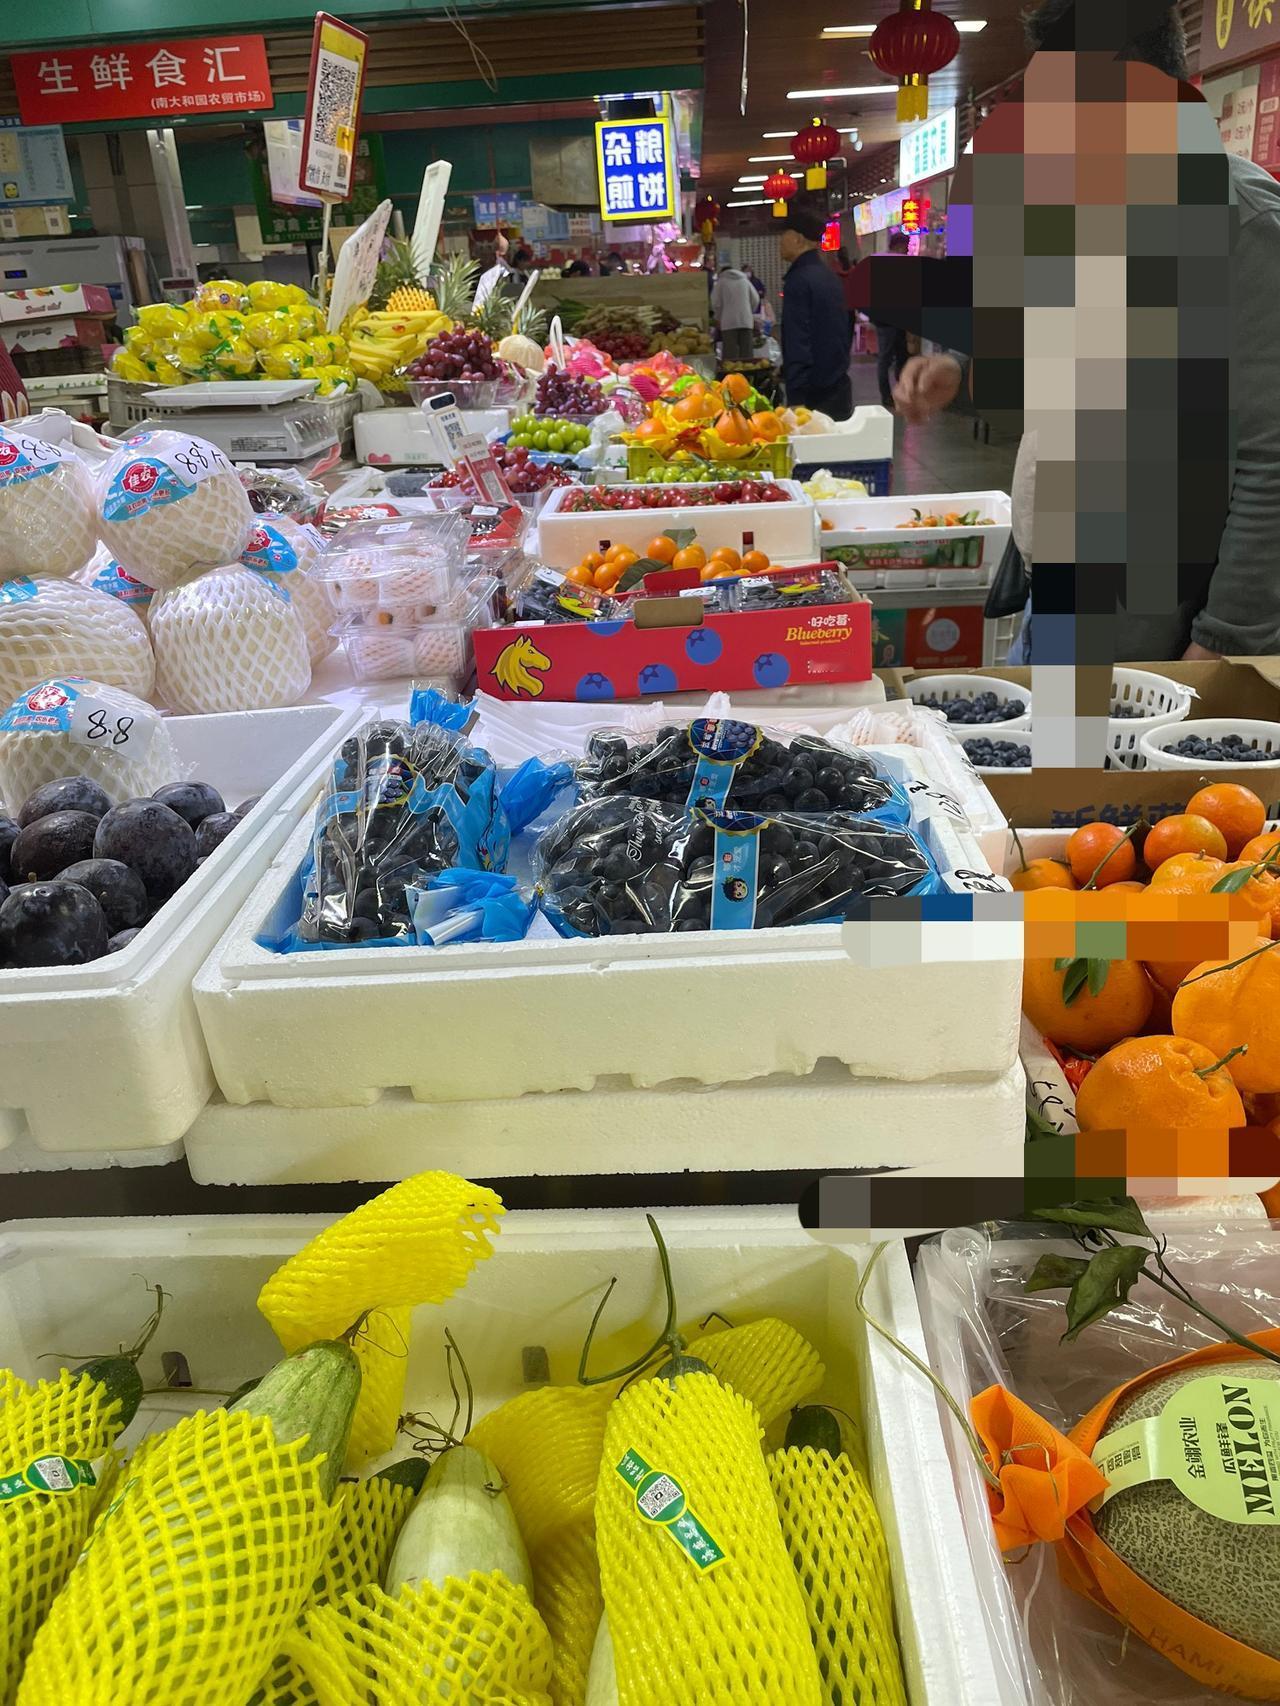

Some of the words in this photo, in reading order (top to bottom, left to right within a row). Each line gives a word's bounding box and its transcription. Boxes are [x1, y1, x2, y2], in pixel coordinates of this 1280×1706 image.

[37, 45, 247, 95] 生鲜食汇
[604, 129, 664, 167] 杂粮
[606, 172, 666, 210] 煎饼
[784, 626, 853, 642] Blueberry
[87, 709, 135, 745] 8.8
[1220, 1382, 1277, 1517] MELON
[1148, 1626, 1225, 1676] HAMI
